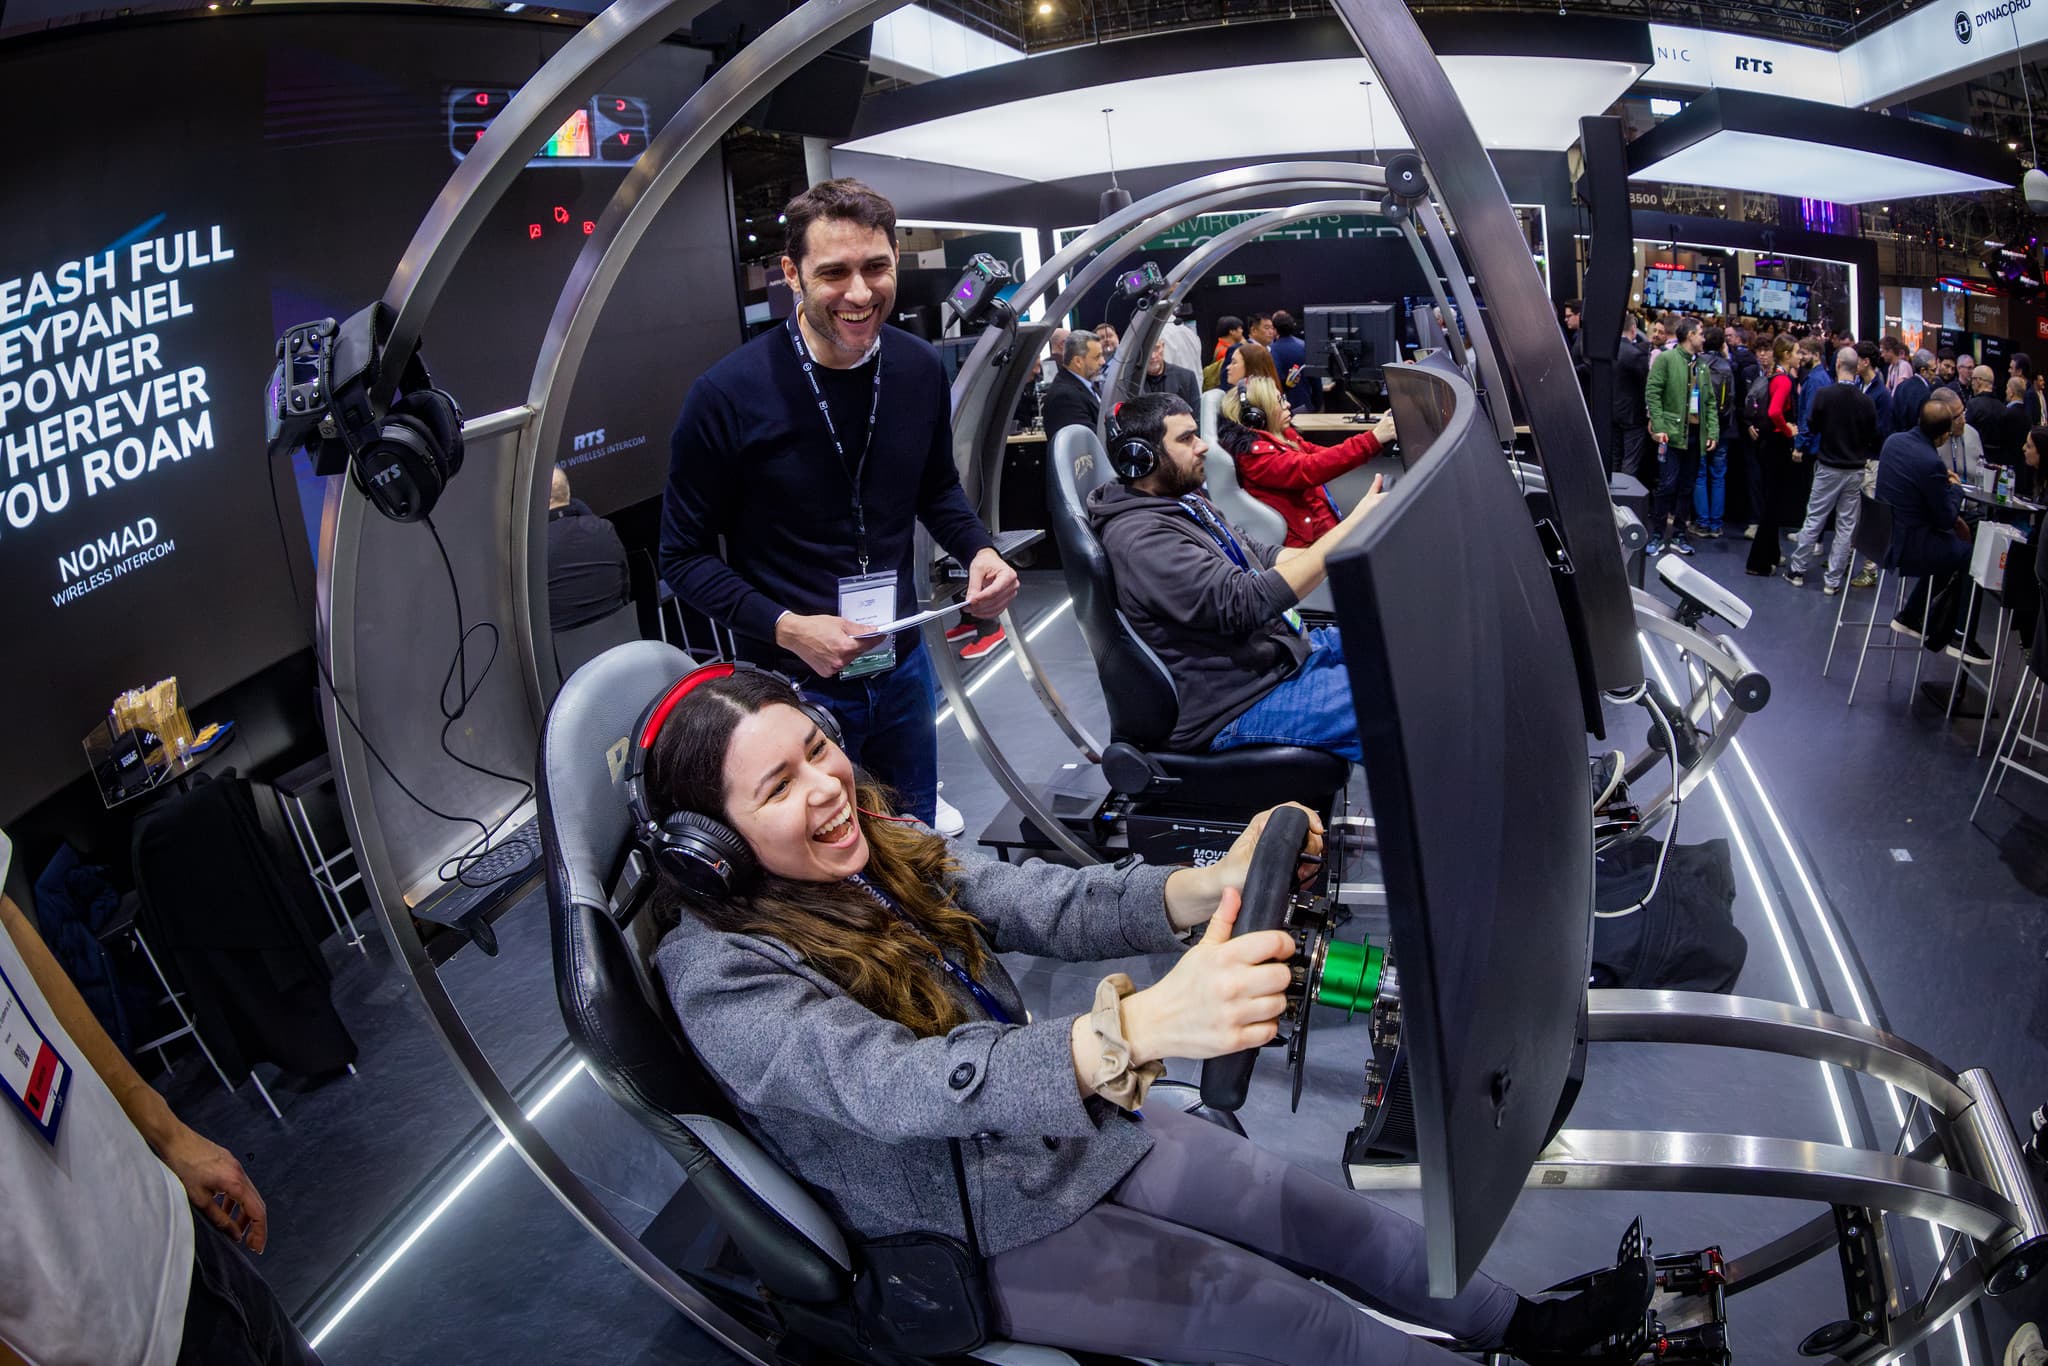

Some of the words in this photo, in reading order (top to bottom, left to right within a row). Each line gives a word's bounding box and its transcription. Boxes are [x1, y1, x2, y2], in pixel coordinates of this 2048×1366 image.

[1976, 0, 2031, 27] DYNACORD
[1735, 56, 1773, 74] RTS
[131, 225, 234, 282] FULL
[0, 279, 193, 376] EYPANEL
[0, 333, 163, 430] POWER
[0, 366, 210, 478] HEREVER
[567, 448, 606, 467] WIRELESS
[607, 435, 646, 454] INTERCOM
[573, 428, 605, 452] RTS
[82, 410, 214, 496] ROAM
[52, 567, 112, 607] WIRELESS
[114, 539, 175, 577] INTERCOM
[58, 517, 157, 583] NOMAD
[848, 873, 891, 909] PTOWN
